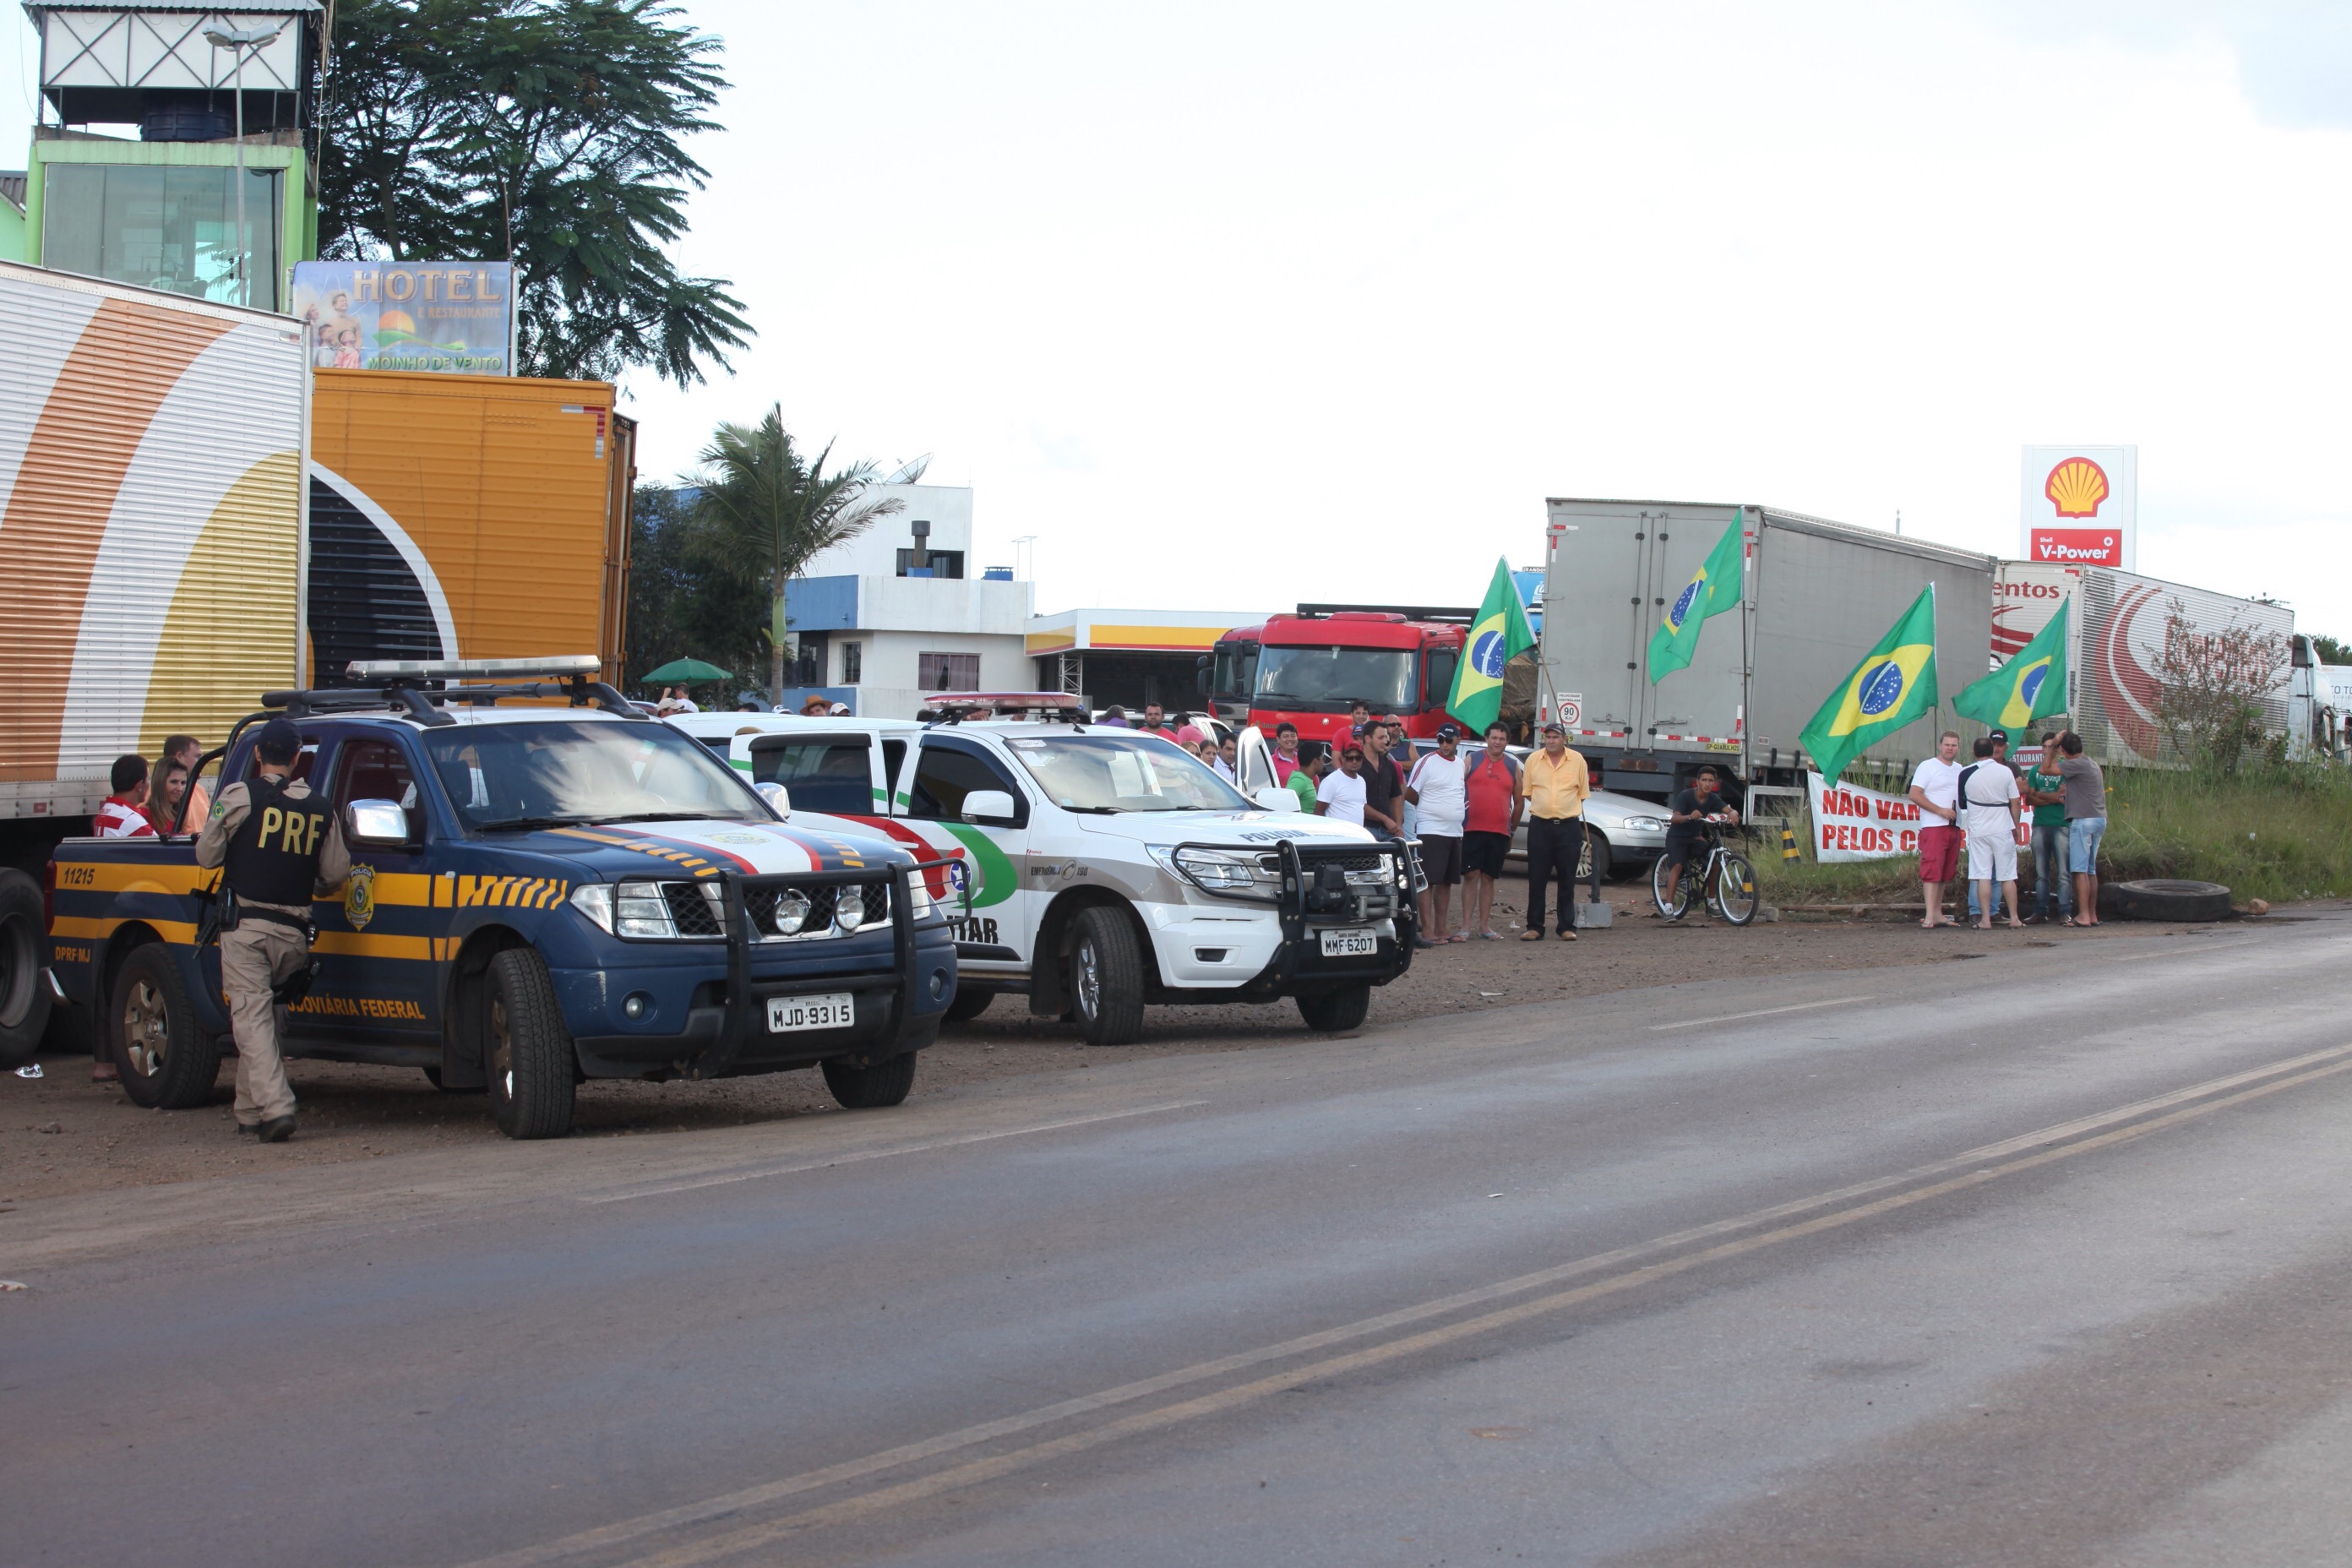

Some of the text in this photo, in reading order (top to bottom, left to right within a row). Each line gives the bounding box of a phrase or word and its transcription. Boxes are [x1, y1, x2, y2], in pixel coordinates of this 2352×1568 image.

[353, 270, 504, 302] HOTEL
[417, 308, 501, 318] E RESTAURANTE
[367, 357, 503, 370] MOINHO DE VENTO
[2040, 545, 2110, 559] V-Power
[1564, 707, 1574, 716] 90
[2009, 754, 2044, 762] STAURANT
[1822, 787, 1869, 821] NÃO
[258, 807, 324, 856] PRF
[1822, 825, 1893, 852] PELOS
[64, 868, 95, 885] 11215
[1077, 867, 1088, 876] 190
[947, 915, 999, 944] ITAR
[359, 999, 426, 1020] FEDERAL
